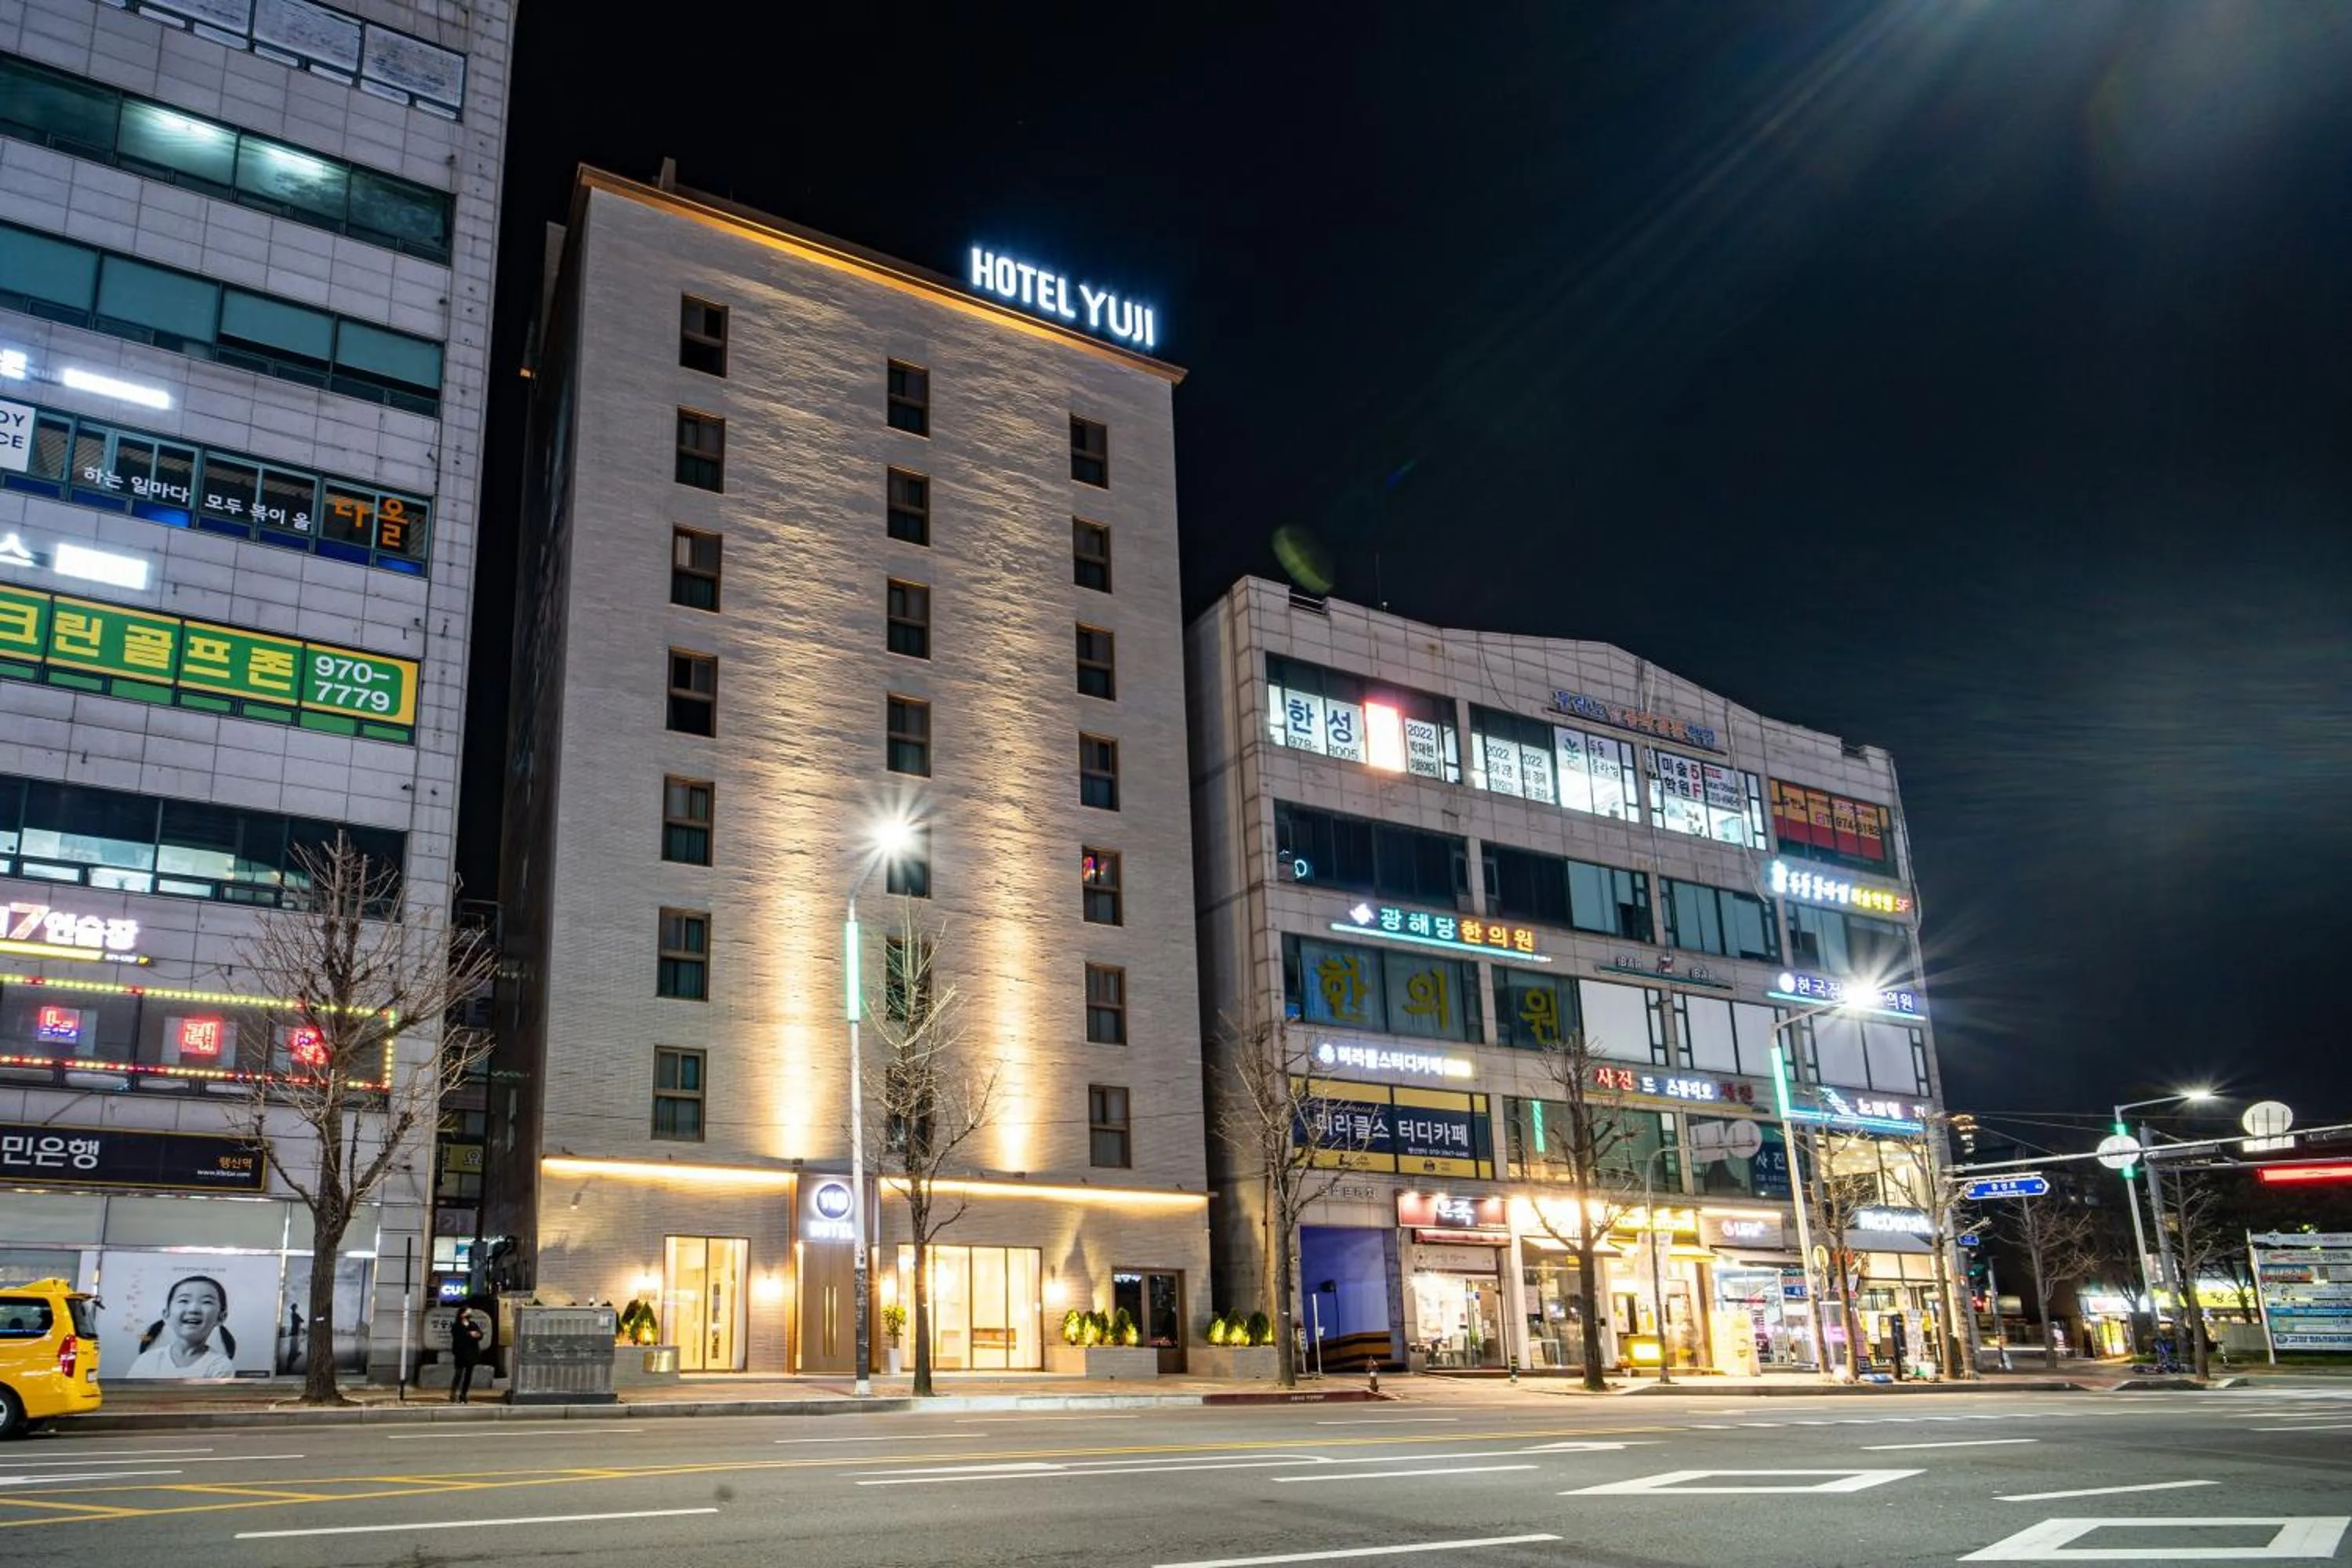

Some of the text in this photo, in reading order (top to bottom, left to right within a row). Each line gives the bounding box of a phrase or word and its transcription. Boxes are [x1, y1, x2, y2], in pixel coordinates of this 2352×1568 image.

[972, 248, 1154, 346] HOTEL YUJI
[84, 466, 123, 489] 하는
[131, 476, 190, 503] 일마다
[205, 494, 243, 515] 모두
[314, 680, 390, 711] 7779
[1289, 699, 1352, 742] 한성
[1407, 723, 1434, 741] 2022
[1661, 757, 1688, 779] 미술
[1596, 1067, 1633, 1091] 사진
